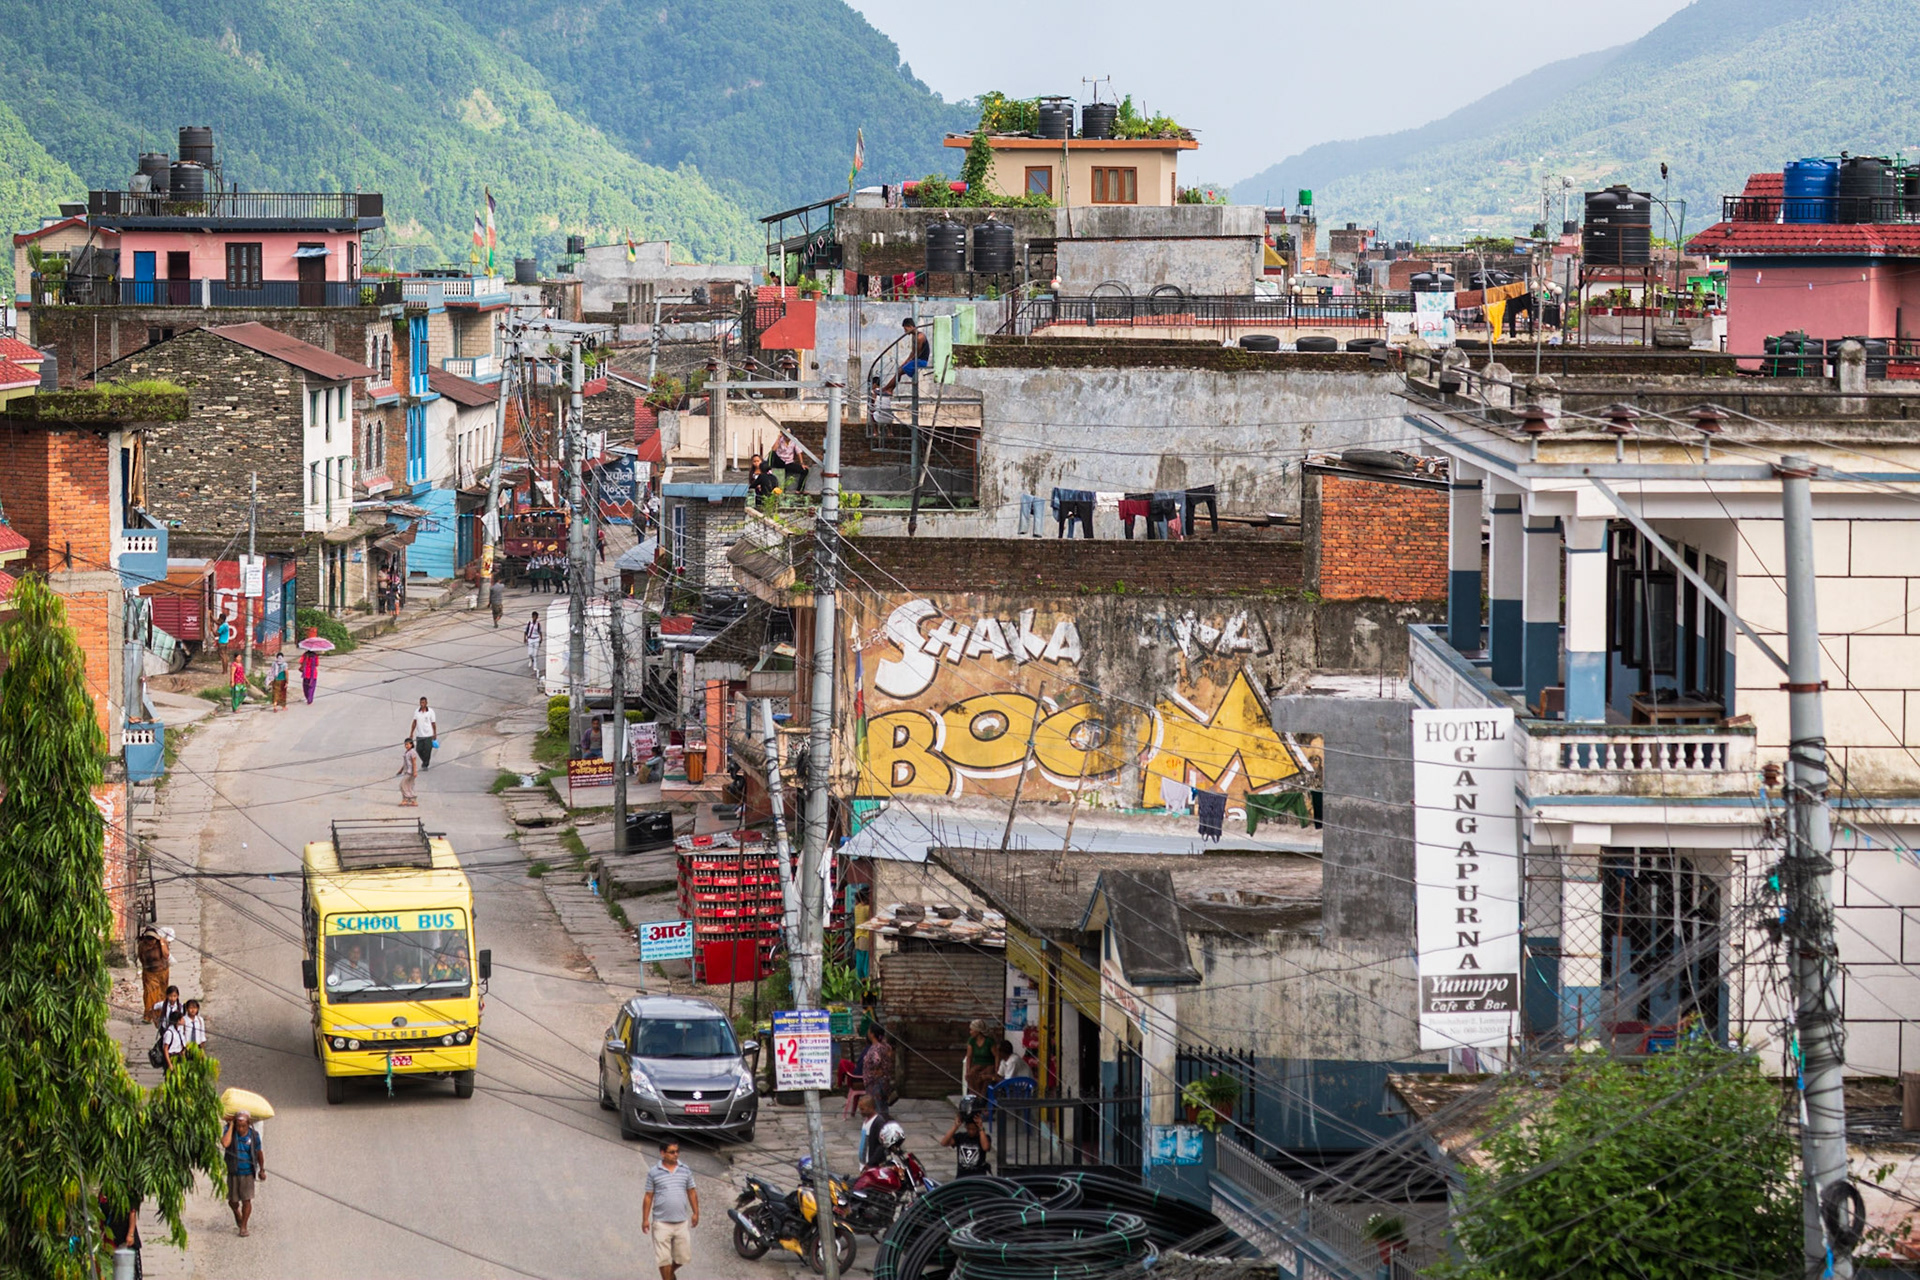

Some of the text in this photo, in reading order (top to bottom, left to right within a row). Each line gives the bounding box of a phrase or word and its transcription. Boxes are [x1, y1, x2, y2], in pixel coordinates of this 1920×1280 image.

[874, 598, 1083, 700] SHAKA
[856, 666, 1306, 808] BOOM
[1424, 720, 1506, 742] HOTEL
[1453, 746, 1481, 970] GANGAPURNA
[336, 913, 455, 931] SCHOOL BUS
[649, 922, 687, 941] आर्ट
[1431, 976, 1509, 998] Yunmpo
[1431, 999, 1508, 1012] Cafe & Bar
[372, 1030, 429, 1040] EICHER
[777, 1038, 798, 1064] +2
